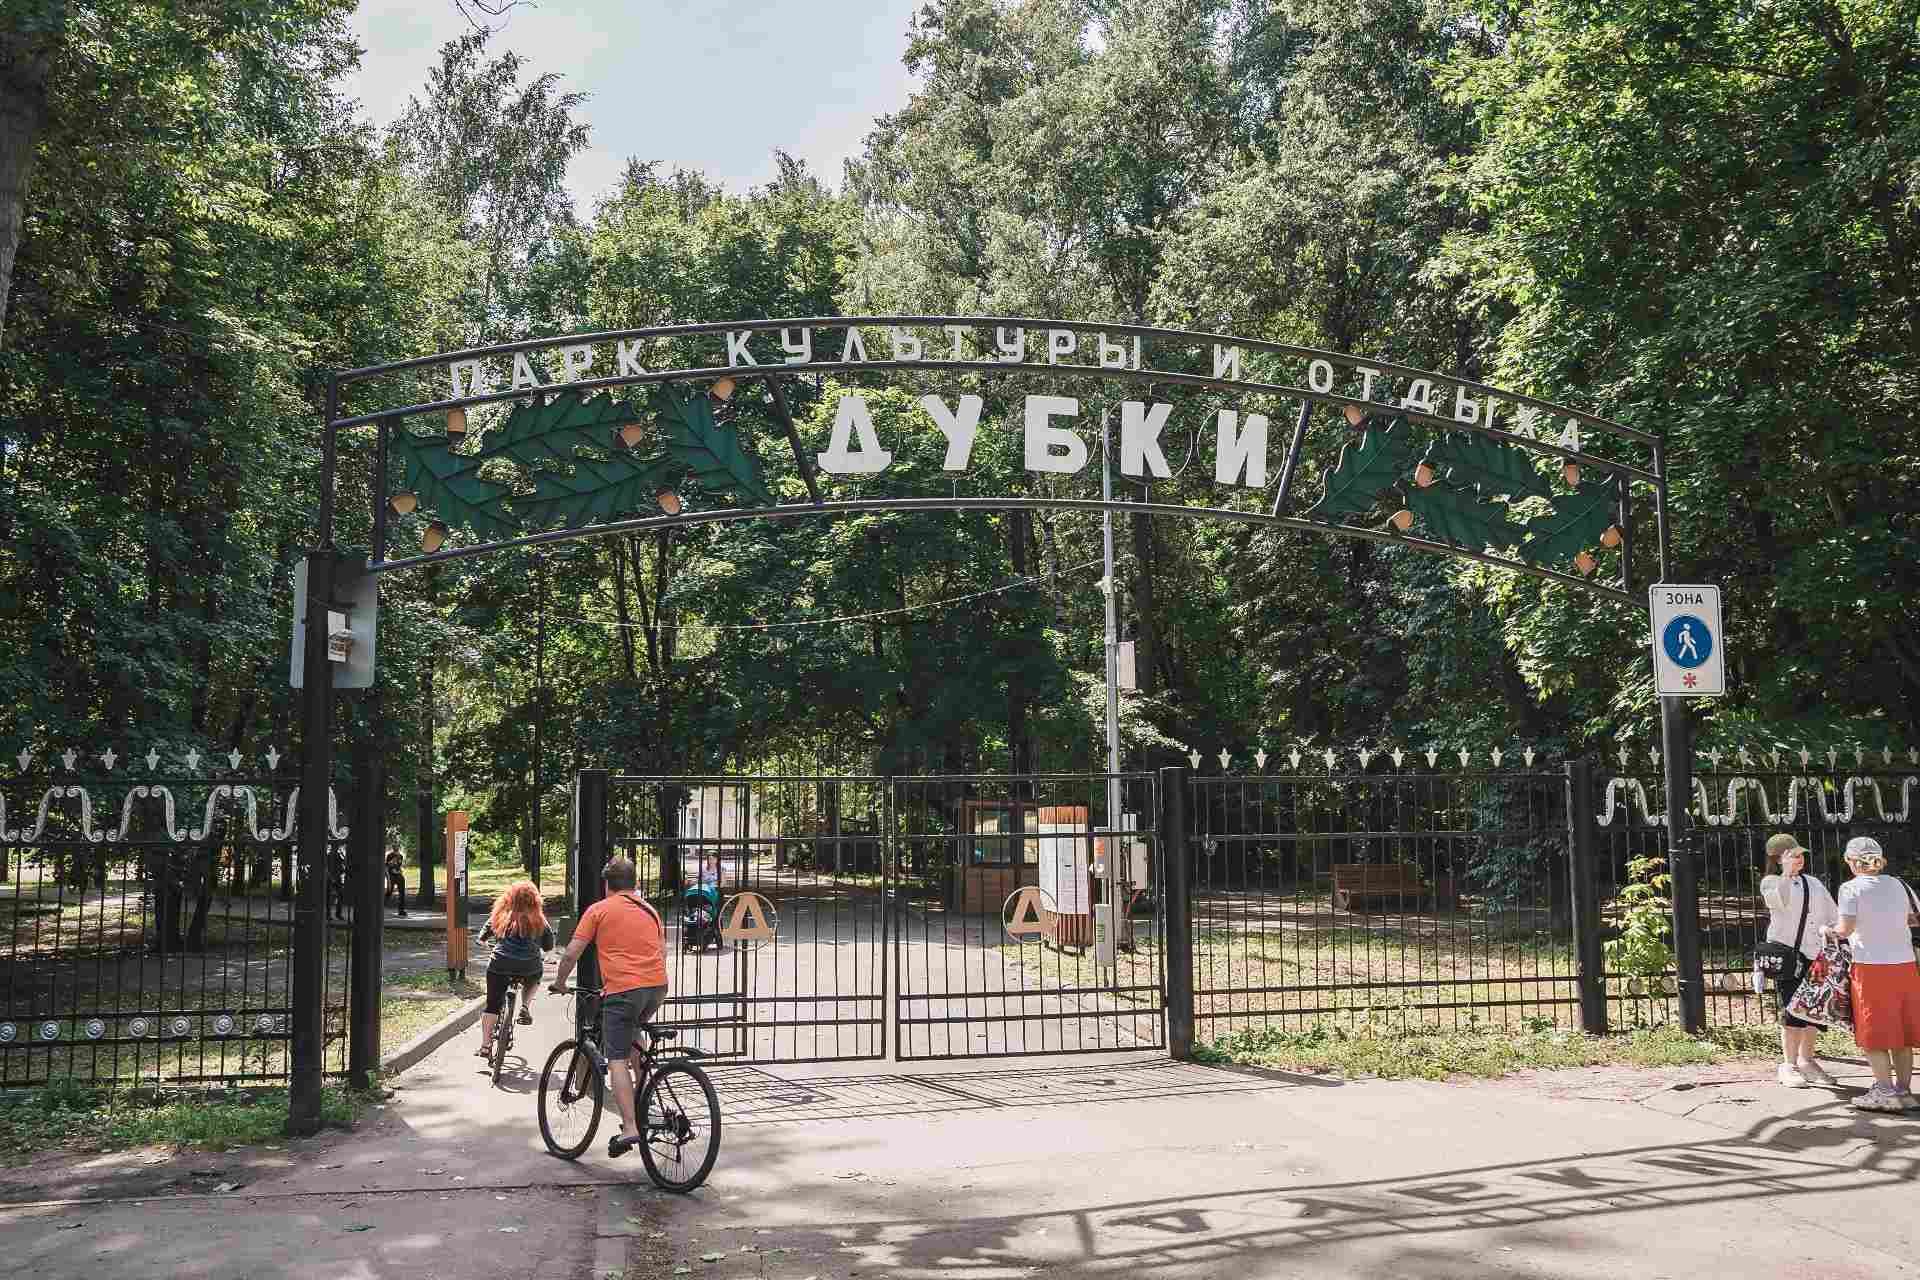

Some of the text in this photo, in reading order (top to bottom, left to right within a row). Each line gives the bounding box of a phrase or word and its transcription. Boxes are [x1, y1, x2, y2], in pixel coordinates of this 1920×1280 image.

[450, 325, 1581, 453] ПАРК КУЛЬТУРЫ И ОТДЫХА
[817, 394, 1268, 488] ДУБКИ
[1666, 592, 1704, 605] ЗОНА
